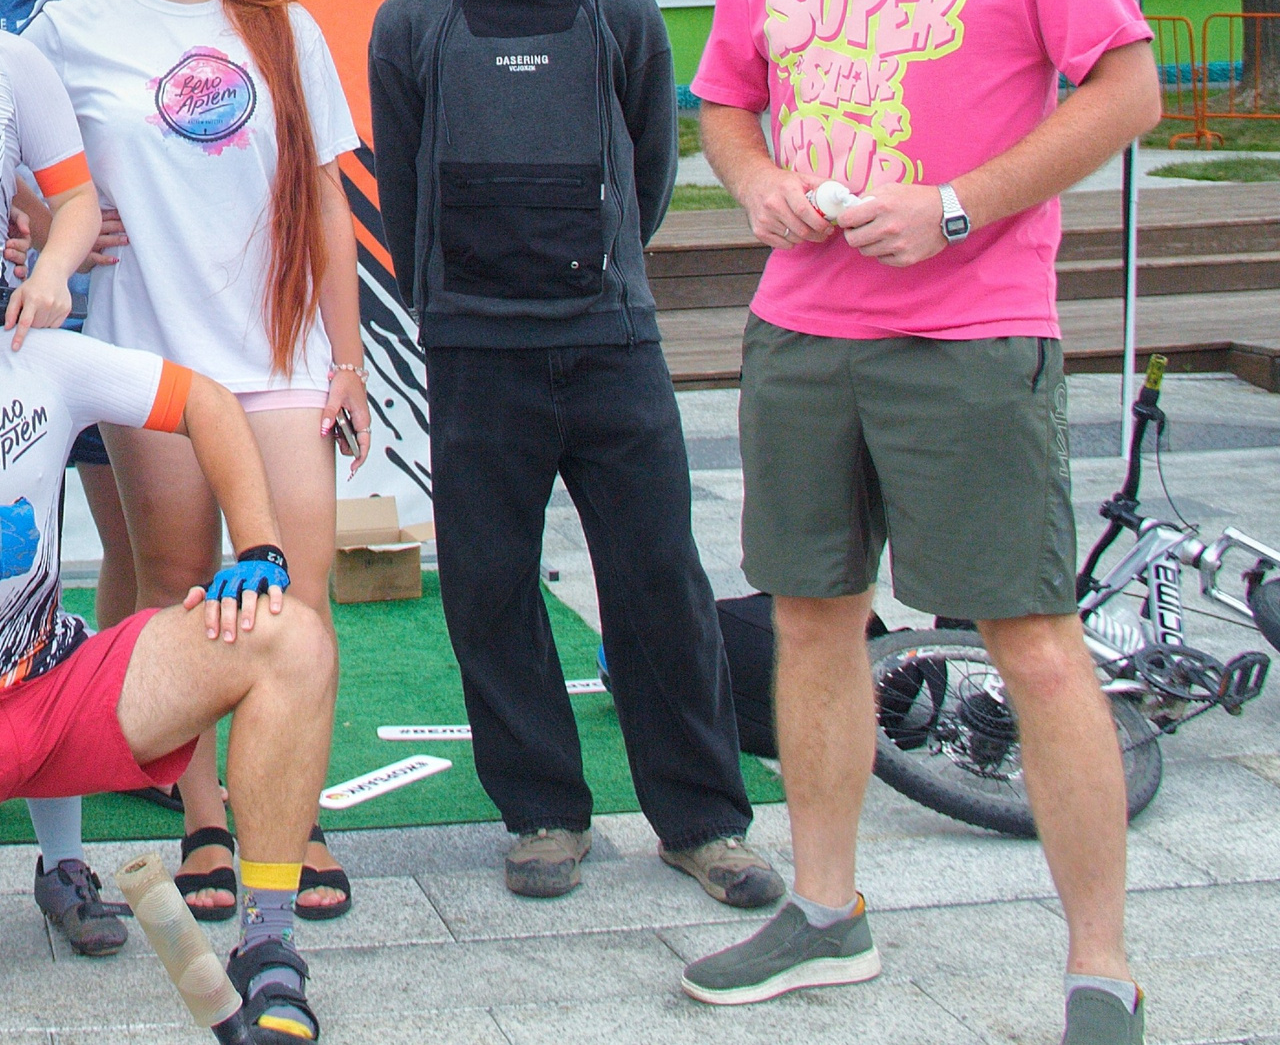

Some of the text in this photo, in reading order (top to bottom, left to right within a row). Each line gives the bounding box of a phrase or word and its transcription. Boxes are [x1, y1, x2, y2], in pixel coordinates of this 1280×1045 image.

[496, 55, 549, 65] DASERING
[175, 75, 222, 98] Вело
[800, 48, 899, 108] STAR
[176, 87, 237, 116] Артём
